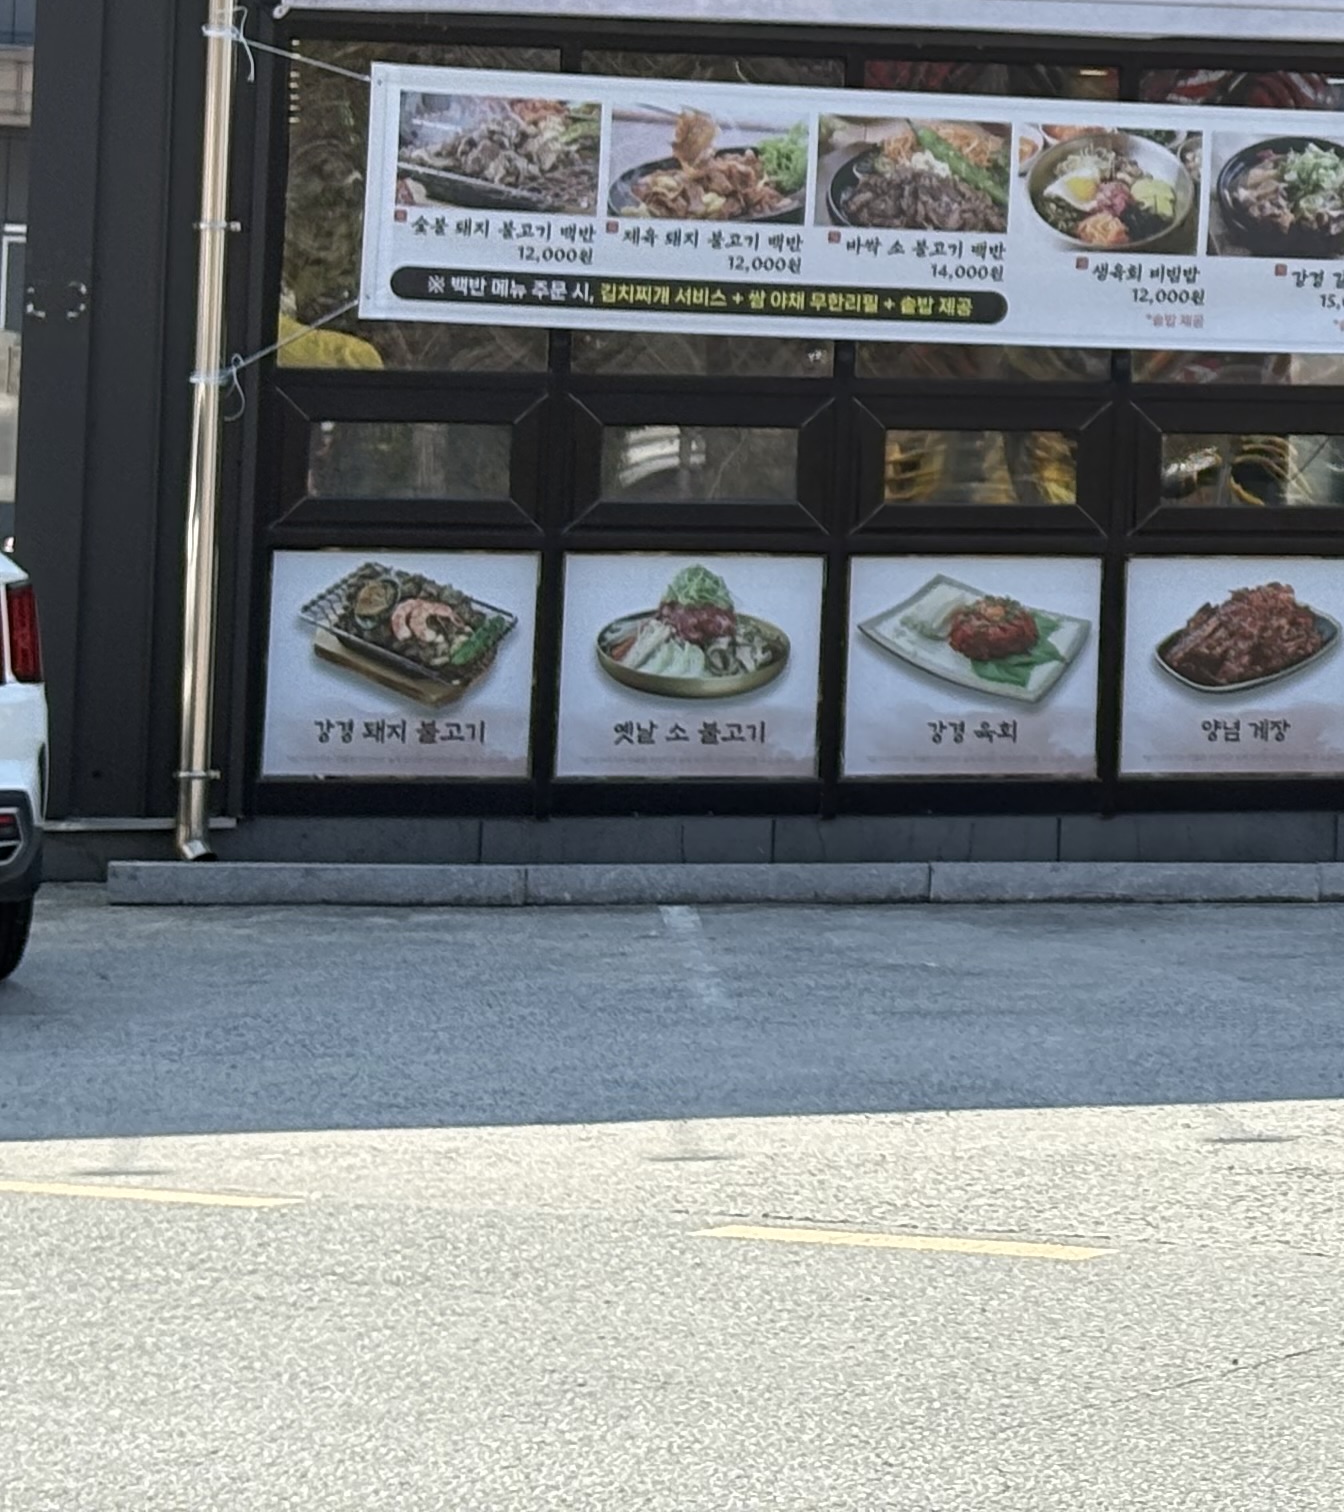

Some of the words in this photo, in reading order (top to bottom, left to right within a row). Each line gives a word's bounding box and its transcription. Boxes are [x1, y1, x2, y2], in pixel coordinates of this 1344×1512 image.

[455, 218, 490, 238] 돼지
[498, 220, 551, 242] 불고기
[560, 223, 596, 244] 백반
[665, 228, 699, 249] 돼지
[708, 229, 759, 251] 불고기
[768, 232, 803, 253] 백반
[517, 245, 594, 265] 12,000원
[887, 240, 906, 256] 소
[912, 239, 963, 260] 불고기
[971, 241, 1007, 261] 백반
[728, 254, 801, 274] 12,000원
[931, 263, 1004, 282] 14,000원
[1150, 265, 1201, 284] 비빔밥
[451, 275, 487, 296] 백반
[491, 279, 527, 299] 메뉴
[531, 280, 567, 301] 주문
[601, 282, 670, 305] 김치찌개
[675, 285, 727, 307] 서비스
[771, 291, 804, 311] 야채
[810, 292, 879, 314] 무한리필
[938, 297, 973, 317] 제공
[1132, 288, 1205, 306] 12,000원
[314, 718, 354, 744] 강경
[362, 718, 407, 744] 돼지
[416, 719, 486, 745] 불고기
[614, 719, 658, 746] 옛날
[666, 722, 690, 742] 소
[698, 719, 765, 746] 불고기
[927, 720, 965, 745] 강경
[973, 719, 1017, 744] 육회
[1201, 718, 1241, 743] 양념
